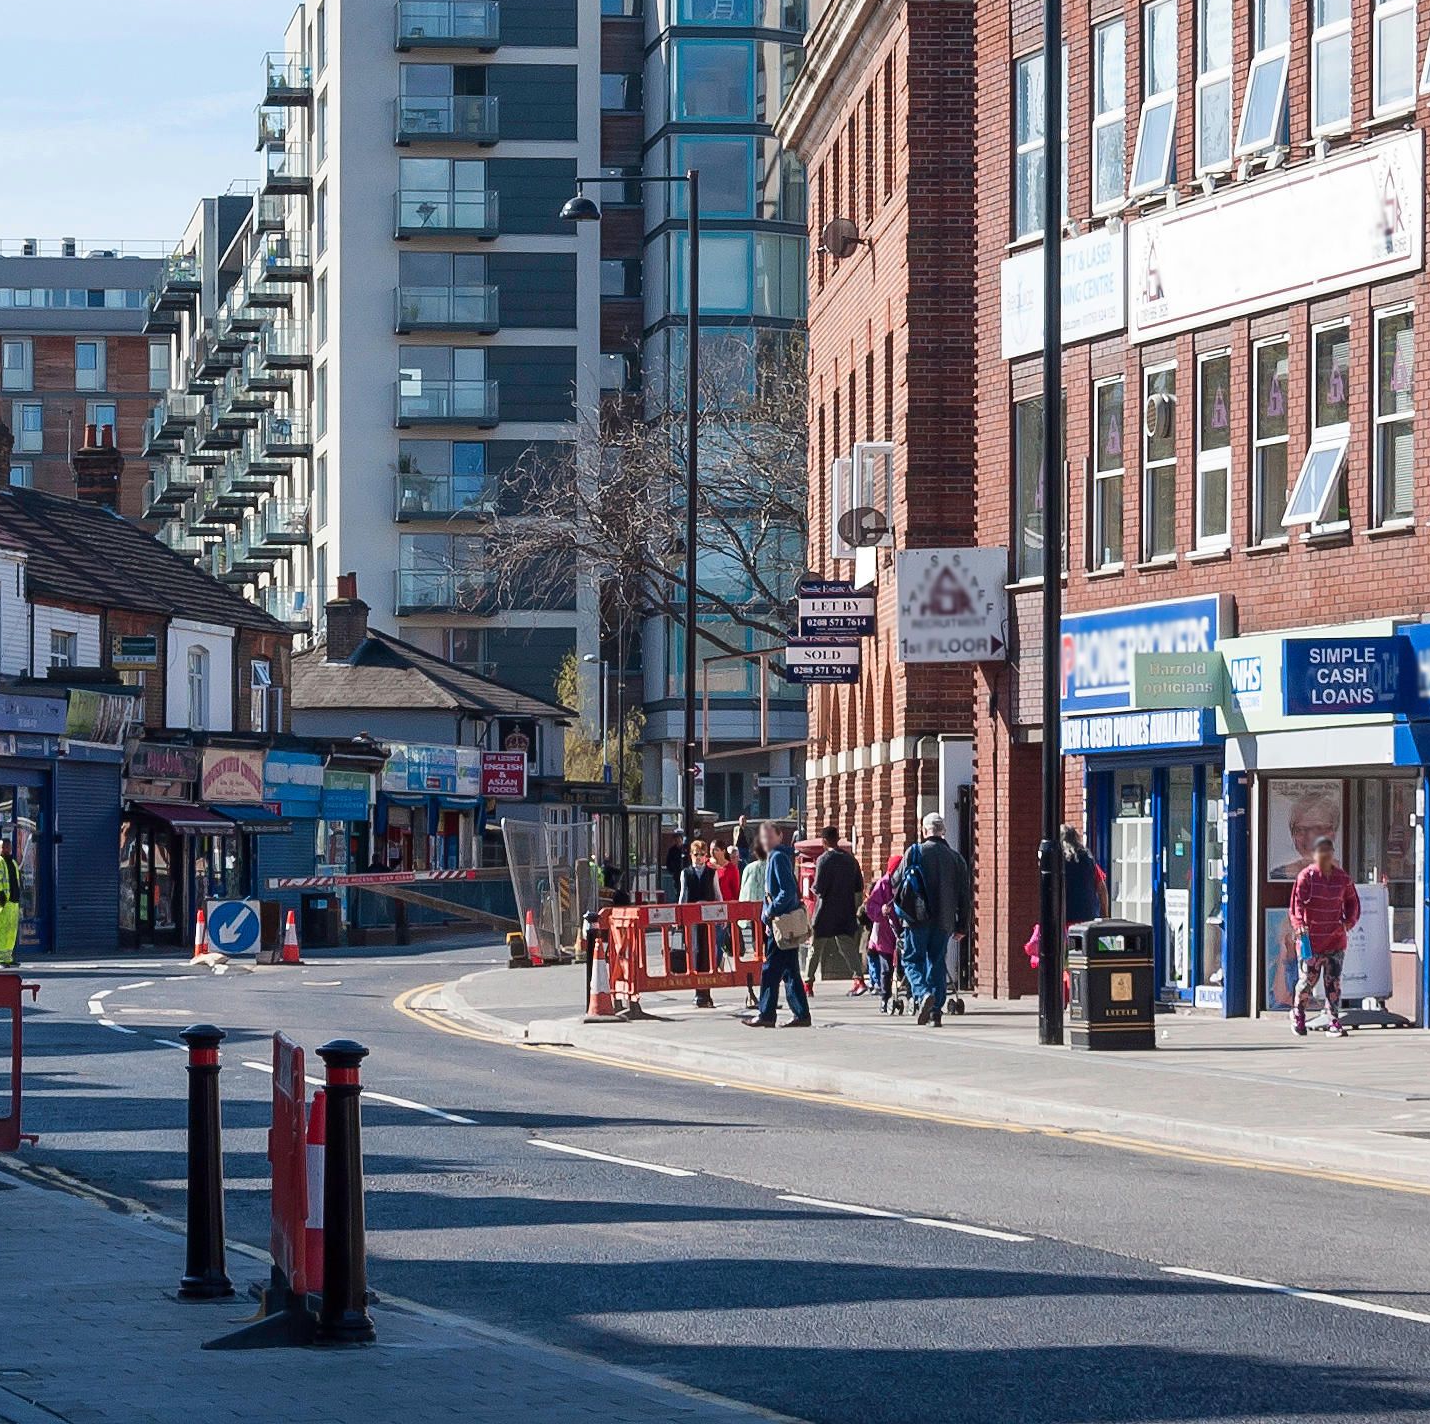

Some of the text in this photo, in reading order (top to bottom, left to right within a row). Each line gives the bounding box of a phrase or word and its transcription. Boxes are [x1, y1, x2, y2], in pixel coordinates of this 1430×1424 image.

[1087, 242, 1113, 268] LASER
[1083, 272, 1115, 300] CENTRE
[811, 601, 861, 611] LET BY
[830, 619, 844, 627] 571
[847, 618, 867, 626] 7614
[901, 638, 988, 654] 1st FLOOR
[804, 650, 841, 660] SOLD
[1309, 647, 1376, 664] SIMPLE
[815, 667, 829, 675] 571
[832, 666, 851, 675] 7614
[1150, 662, 1207, 676] Harrold
[1232, 658, 1261, 691] NHS
[1317, 668, 1367, 684] CASH
[1143, 680, 1213, 698] opticians
[1311, 688, 1374, 704] LOANS
[1082, 718, 1090, 748] &
[1090, 717, 1113, 748] USED
[1114, 714, 1149, 746] PHONES
[1149, 710, 1200, 744] AVAILABLE
[483, 763, 524, 771] ENGLISH
[487, 786, 519, 794] FOODS
[1105, 1008, 1138, 1017] LITTER
